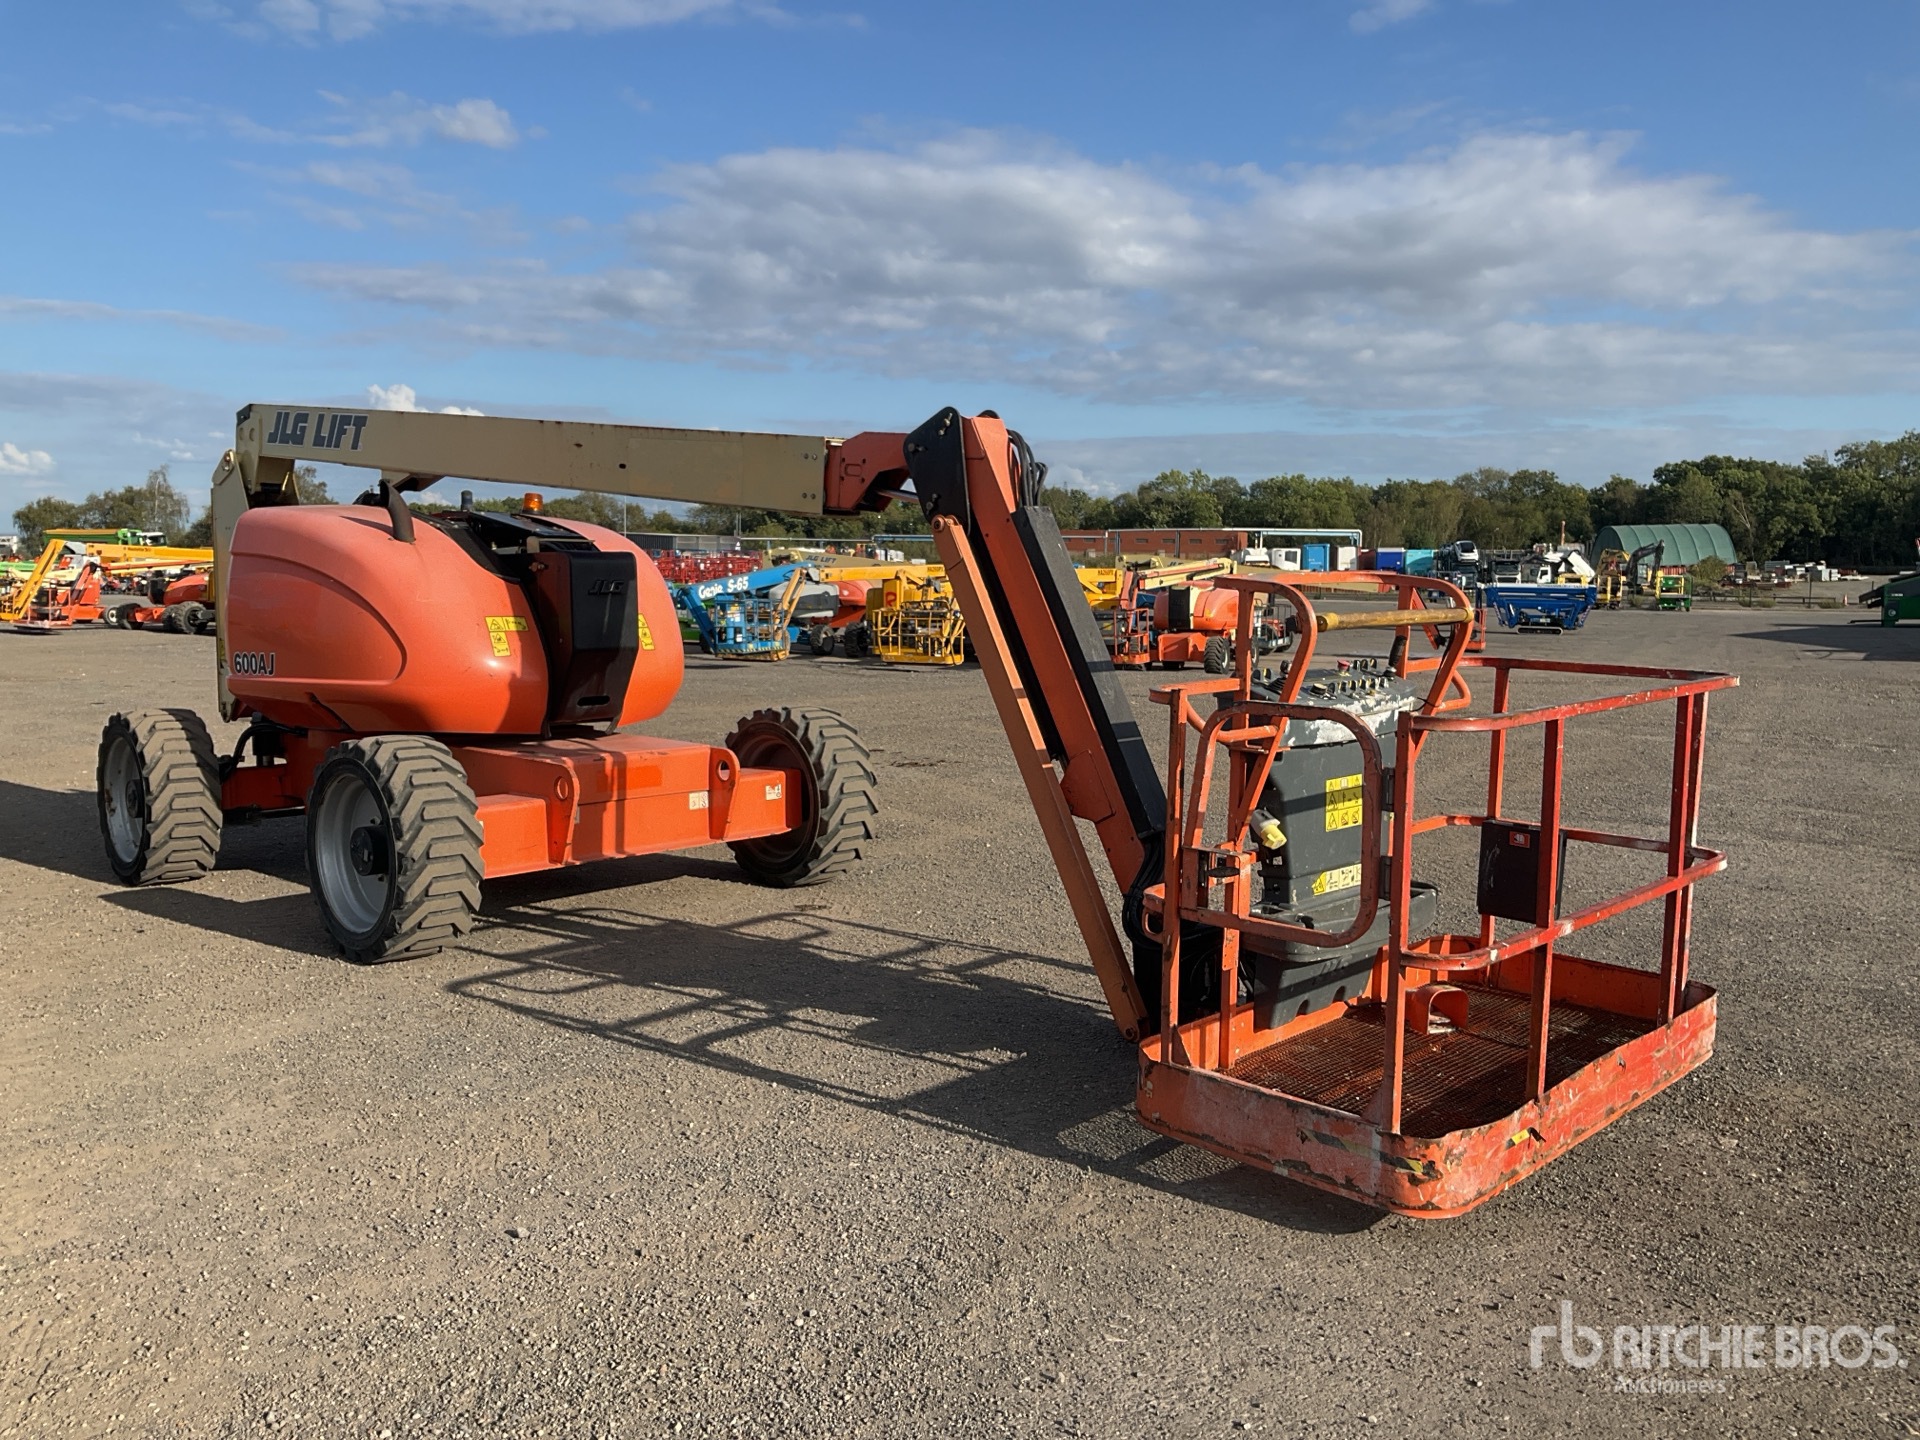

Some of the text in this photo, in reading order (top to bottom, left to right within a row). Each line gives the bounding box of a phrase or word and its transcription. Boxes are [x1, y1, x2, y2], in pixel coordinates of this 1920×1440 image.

[267, 410, 369, 451] JLG LIFT
[588, 579, 625, 596] JLG
[698, 575, 750, 600] Genie S-65
[233, 651, 276, 676] 600AJ
